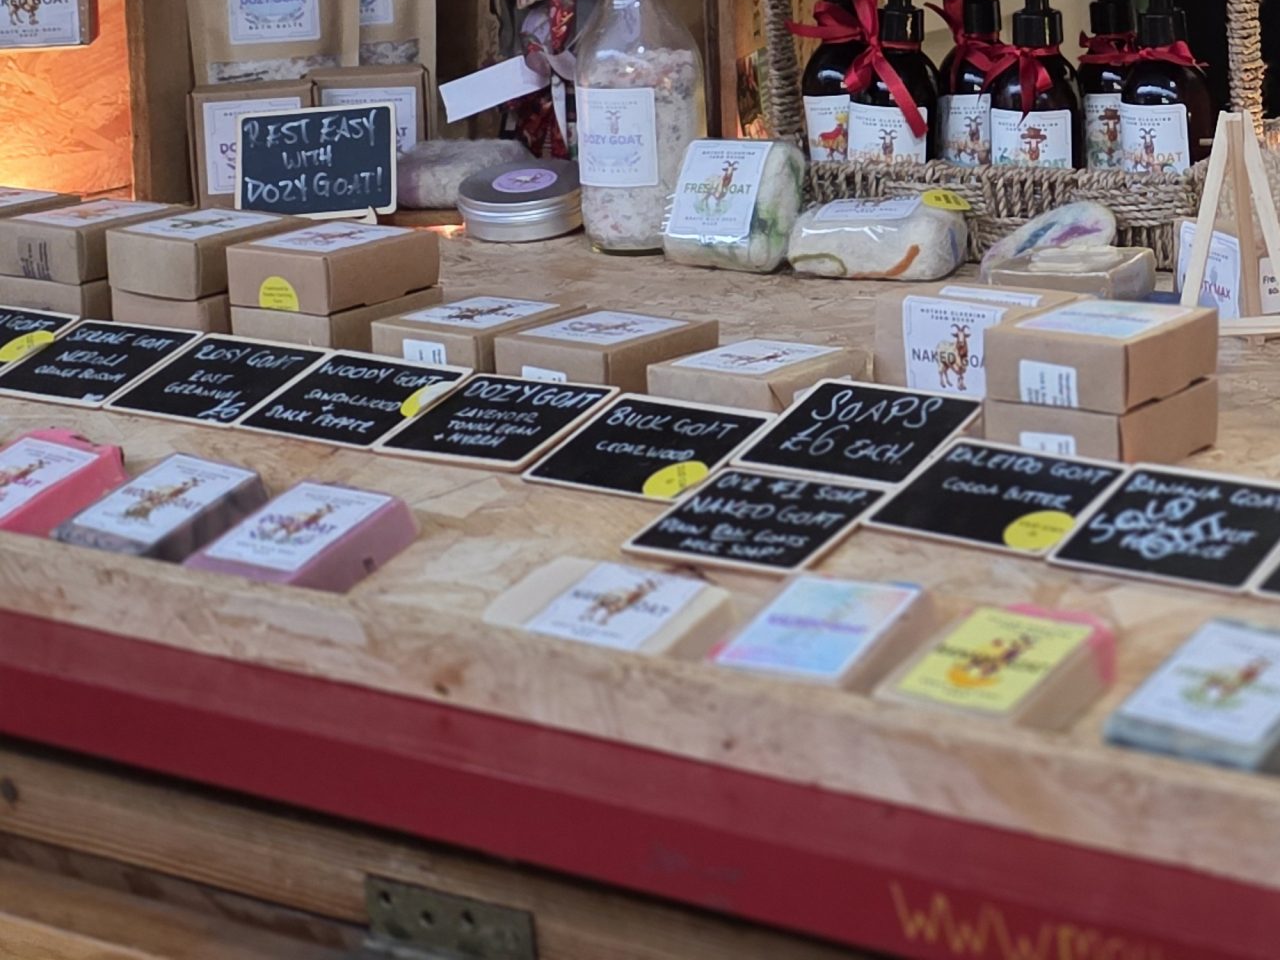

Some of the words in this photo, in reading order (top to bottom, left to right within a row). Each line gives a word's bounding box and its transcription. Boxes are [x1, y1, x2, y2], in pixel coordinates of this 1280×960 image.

[244, 118, 310, 148] REST
[320, 109, 377, 147] EASY
[609, 134, 644, 146] GOAT
[282, 145, 332, 170] WITH
[244, 174, 307, 204] DOZY
[313, 166, 383, 197] GOAT!
[684, 182, 719, 195] FRESH
[7, 314, 56, 331] GOAT
[131, 332, 174, 351] GOAT
[55, 350, 128, 367] NEROLI
[194, 343, 252, 363] ROSY
[247, 348, 304, 370] GOAT
[911, 347, 956, 366] NAKED
[961, 355, 985, 368] GOA
[318, 360, 395, 383] WOODY
[393, 370, 445, 389] GOAT
[303, 388, 402, 413] SANDALWOOD
[810, 388, 944, 429] SOAPS
[456, 406, 539, 424] LAVENDER
[605, 405, 673, 432] BUCK
[672, 417, 739, 440] GOAT
[946, 446, 1044, 475] KALEIDO
[1049, 459, 1116, 485] GOAT
[941, 476, 999, 495] COCOA
[1002, 485, 1073, 510] BUTTER
[1124, 473, 1222, 502] BANANA
[685, 494, 776, 521] NAKED
[775, 505, 846, 528] GOAT
